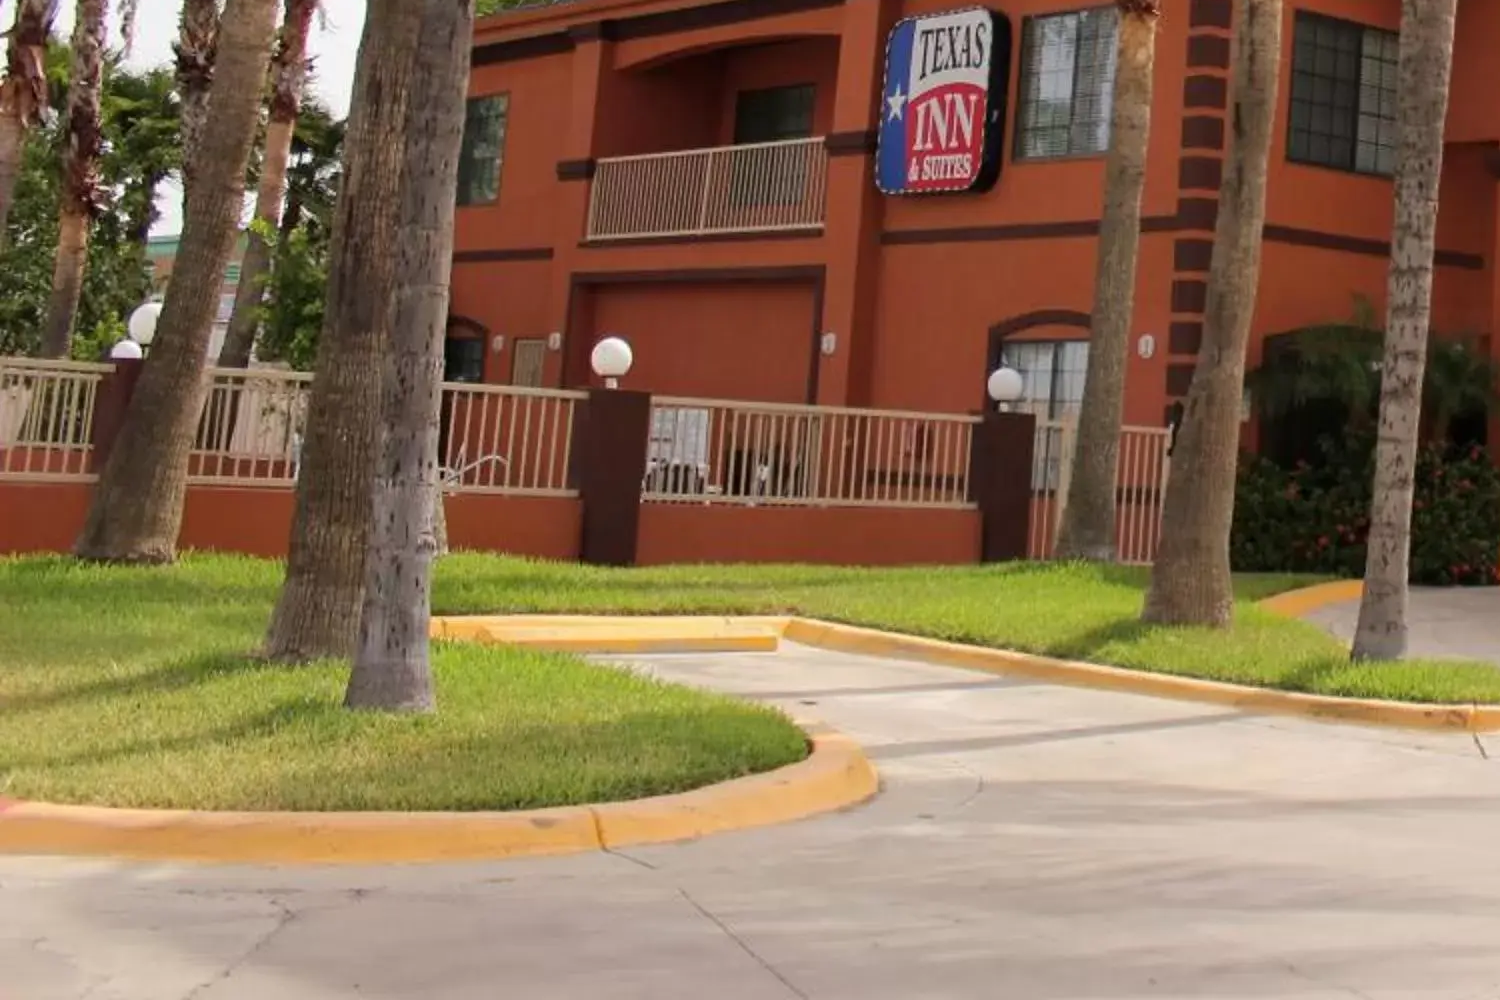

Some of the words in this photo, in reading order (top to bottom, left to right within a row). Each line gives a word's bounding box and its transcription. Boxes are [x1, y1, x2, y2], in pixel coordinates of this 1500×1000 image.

[919, 21, 986, 80] TEXAS
[912, 92, 979, 151] INN
[907, 157, 919, 182] &
[921, 153, 972, 181] SUITES
